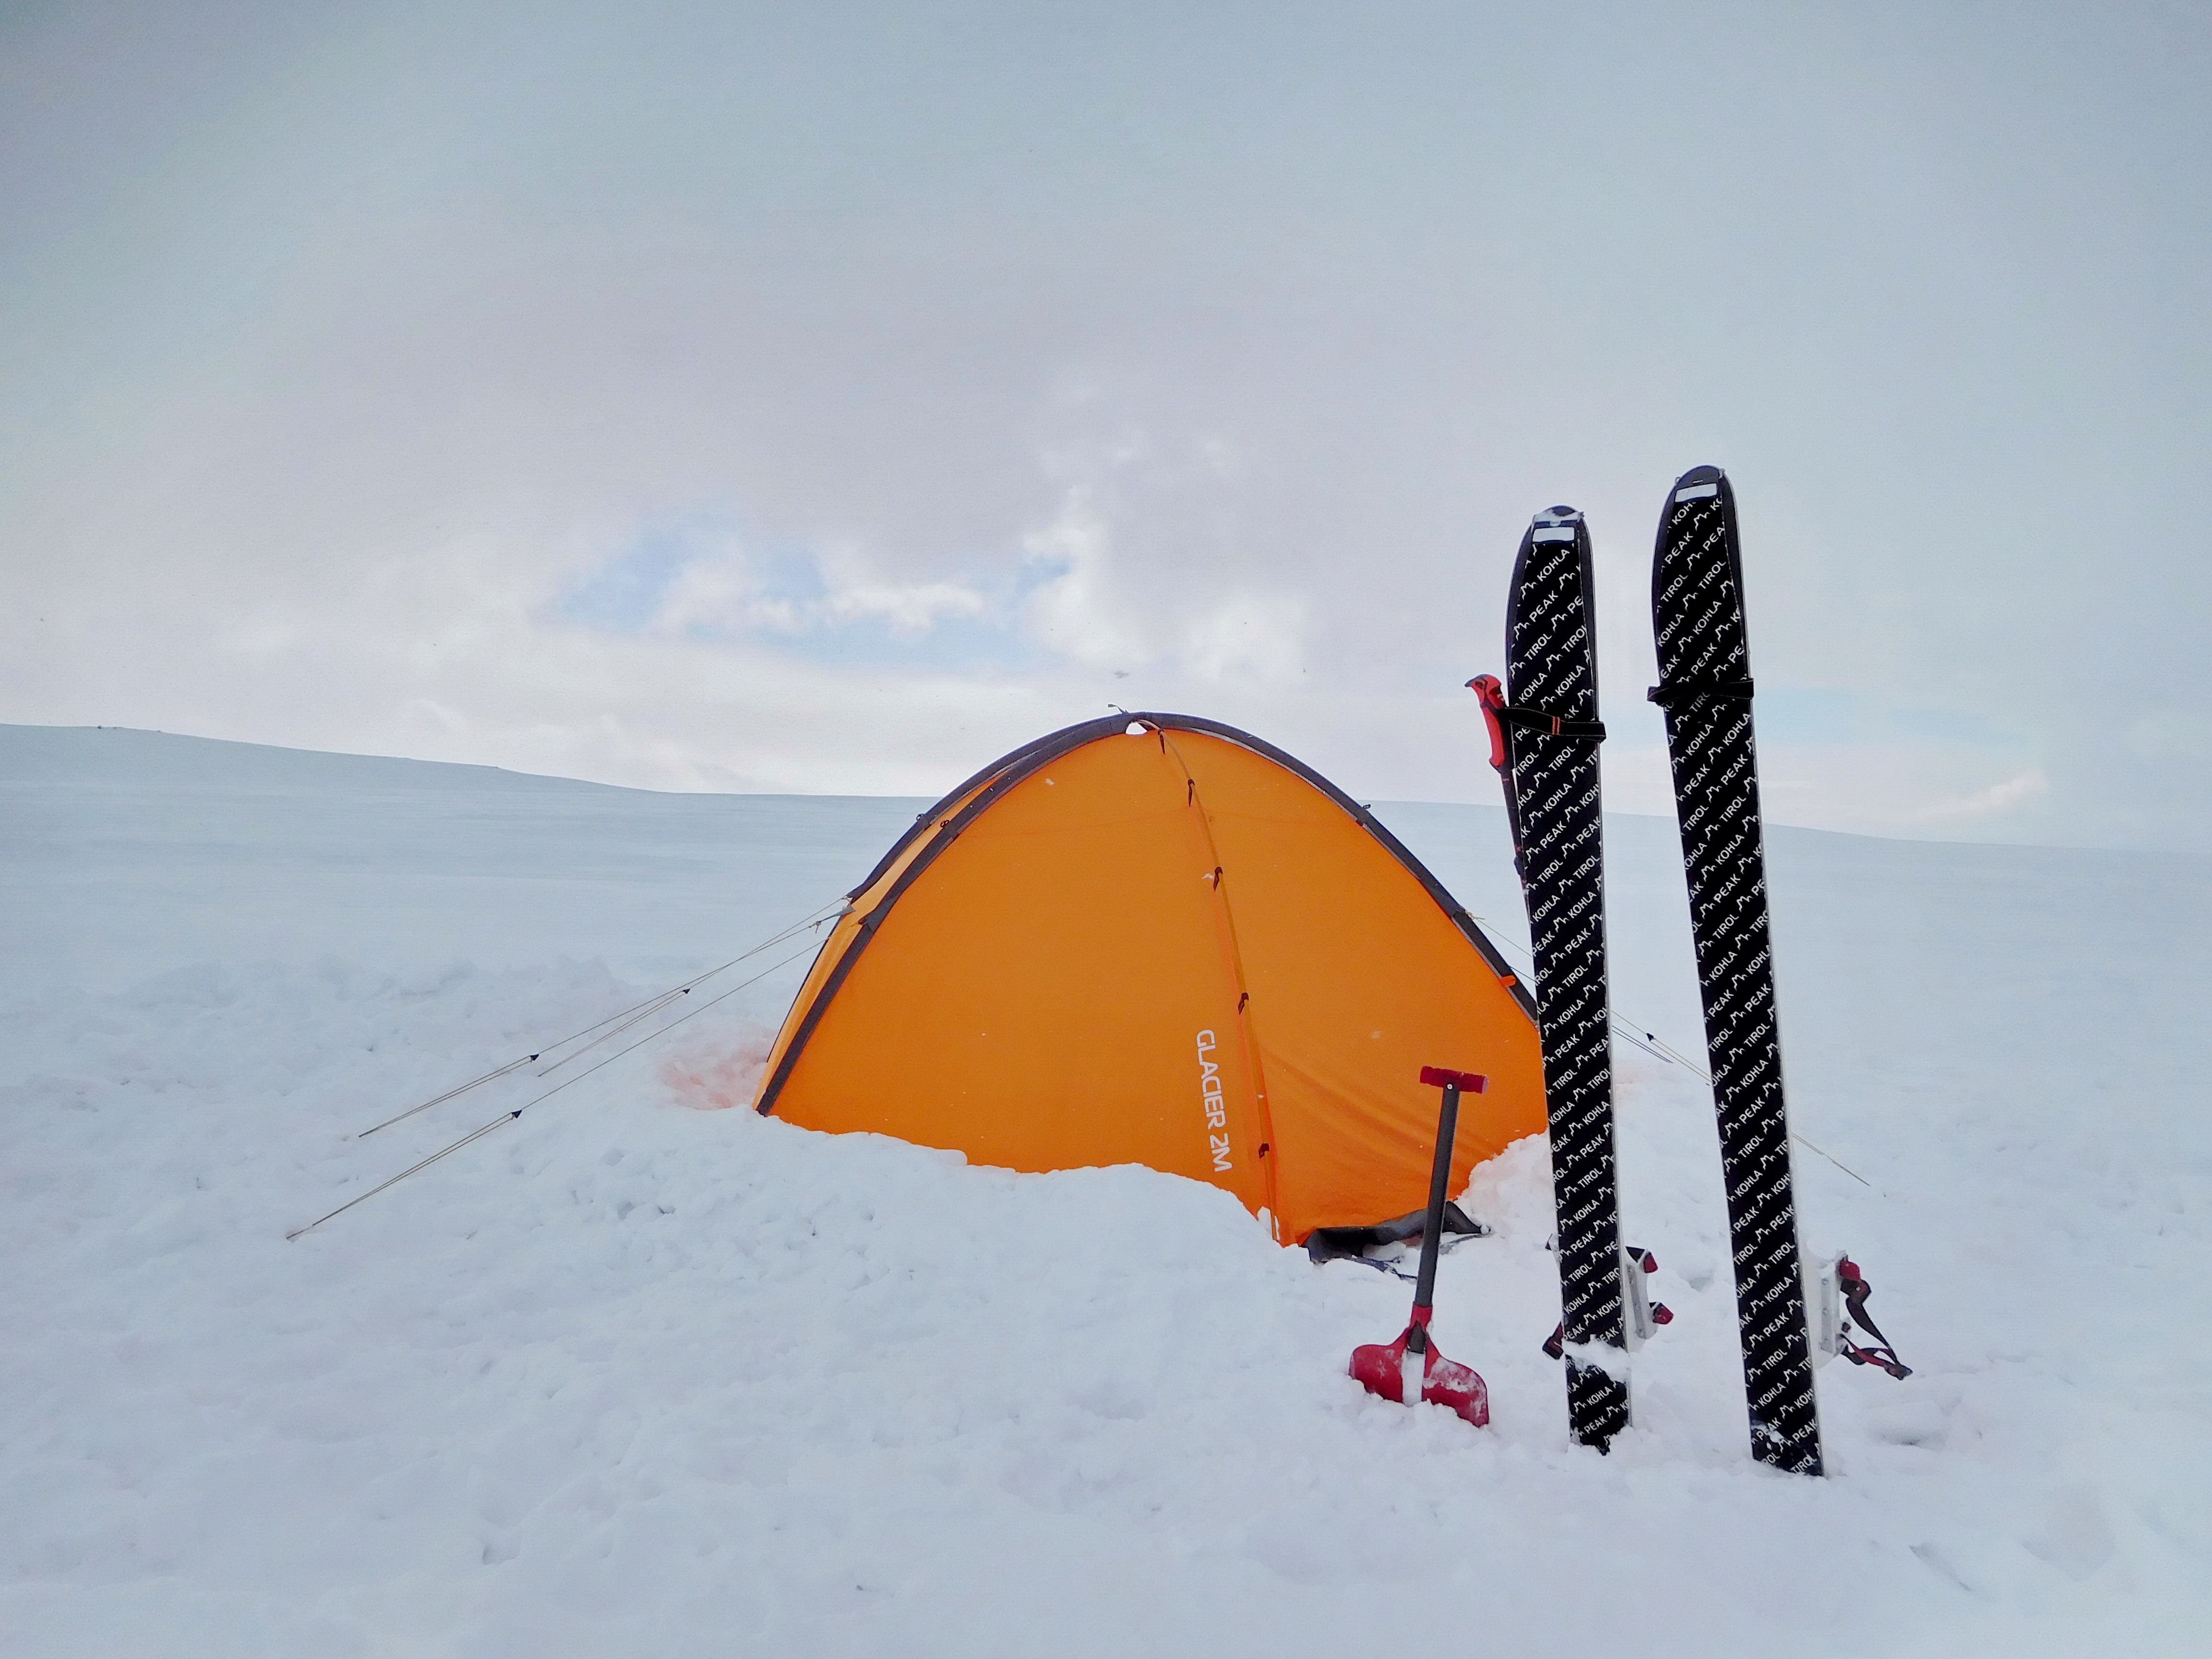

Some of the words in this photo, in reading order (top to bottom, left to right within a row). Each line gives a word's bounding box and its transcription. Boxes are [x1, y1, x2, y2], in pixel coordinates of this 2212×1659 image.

[1664, 531, 1693, 564] PEAK
[1537, 549, 1570, 581] KOHLA
[1697, 561, 1726, 589] TIROL
[1660, 574, 1688, 602] TIROL
[1529, 590, 1559, 622] PEAK
[1692, 601, 1721, 635] KOHLA
[1657, 613, 1684, 647] KOHLA
[1524, 634, 1552, 660] TIROL
[1691, 642, 1717, 675] PEAK
[1519, 673, 1548, 703] KOHLA
[1555, 665, 1585, 697] KOHLA
[1685, 724, 1714, 756] KOHLA
[1722, 713, 1752, 746] KOHLA
[1549, 746, 1575, 770] TIROL
[1720, 754, 1748, 785] PEAK
[1683, 764, 1710, 794] PEAK
[1518, 788, 1536, 810] HLA
[1543, 783, 1572, 812] KOHLA
[1719, 796, 1746, 822] TIROL
[1576, 816, 1601, 844] PEAK
[1683, 805, 1709, 830] TIROL
[1540, 820, 1566, 848] PEAK
[1715, 834, 1744, 865] KOHLA
[1537, 859, 1563, 883] TIROL
[1573, 855, 1600, 879] TIROL
[1713, 873, 1741, 903] PEAK
[1532, 895, 1560, 922] KOHLA
[1568, 891, 1597, 918] KOHLA
[1712, 914, 1739, 939] TIROL
[1532, 931, 1555, 957] PEAK
[1564, 928, 1591, 954] PEAK
[1563, 965, 1588, 986] TIROL
[1709, 951, 1737, 980] KOHLA
[1707, 989, 1734, 1017] PEAK
[1744, 983, 1771, 1012] PEAK
[1557, 999, 1585, 1024] KOHLA
[1554, 1034, 1580, 1058] PEAK
[1708, 1028, 1733, 1052] TIROL
[1743, 1023, 1770, 1047] TIROL
[1196, 1029, 1226, 1130] GLACIER
[1552, 1069, 1577, 1090] TIROL
[1740, 1059, 1768, 1088] KOHLA
[1549, 1101, 1575, 1125] KOHLA
[1582, 1101, 1610, 1125] KOHLA
[1739, 1096, 1765, 1124] PEAK
[1210, 1132, 1232, 1172] 2M
[1551, 1134, 1571, 1152] EAK
[1580, 1134, 1605, 1157] PEAK
[1738, 1135, 1764, 1157] TIROL
[1577, 1168, 1603, 1188] TIROL
[1734, 1170, 1763, 1197] KOHLA
[1573, 1200, 1600, 1222] KOHLA
[1733, 1206, 1759, 1232] PEAK
[1770, 1204, 1794, 1230] PEAK
[1570, 1231, 1595, 1253] PEAK
[1733, 1243, 1758, 1265] TIROL
[1768, 1242, 1795, 1264] TIROL
[1568, 1263, 1592, 1282] TIROL
[1764, 1277, 1793, 1302] KOHLA
[1564, 1293, 1590, 1314] KOHLA
[1763, 1312, 1790, 1337] PEAK
[1762, 1348, 1788, 1370] TIROL
[1587, 1386, 1613, 1406] KOHLA
[1758, 1382, 1786, 1407] KOHLA
[1584, 1416, 1608, 1434] PEAK
[1792, 1419, 1817, 1443] PEAK
